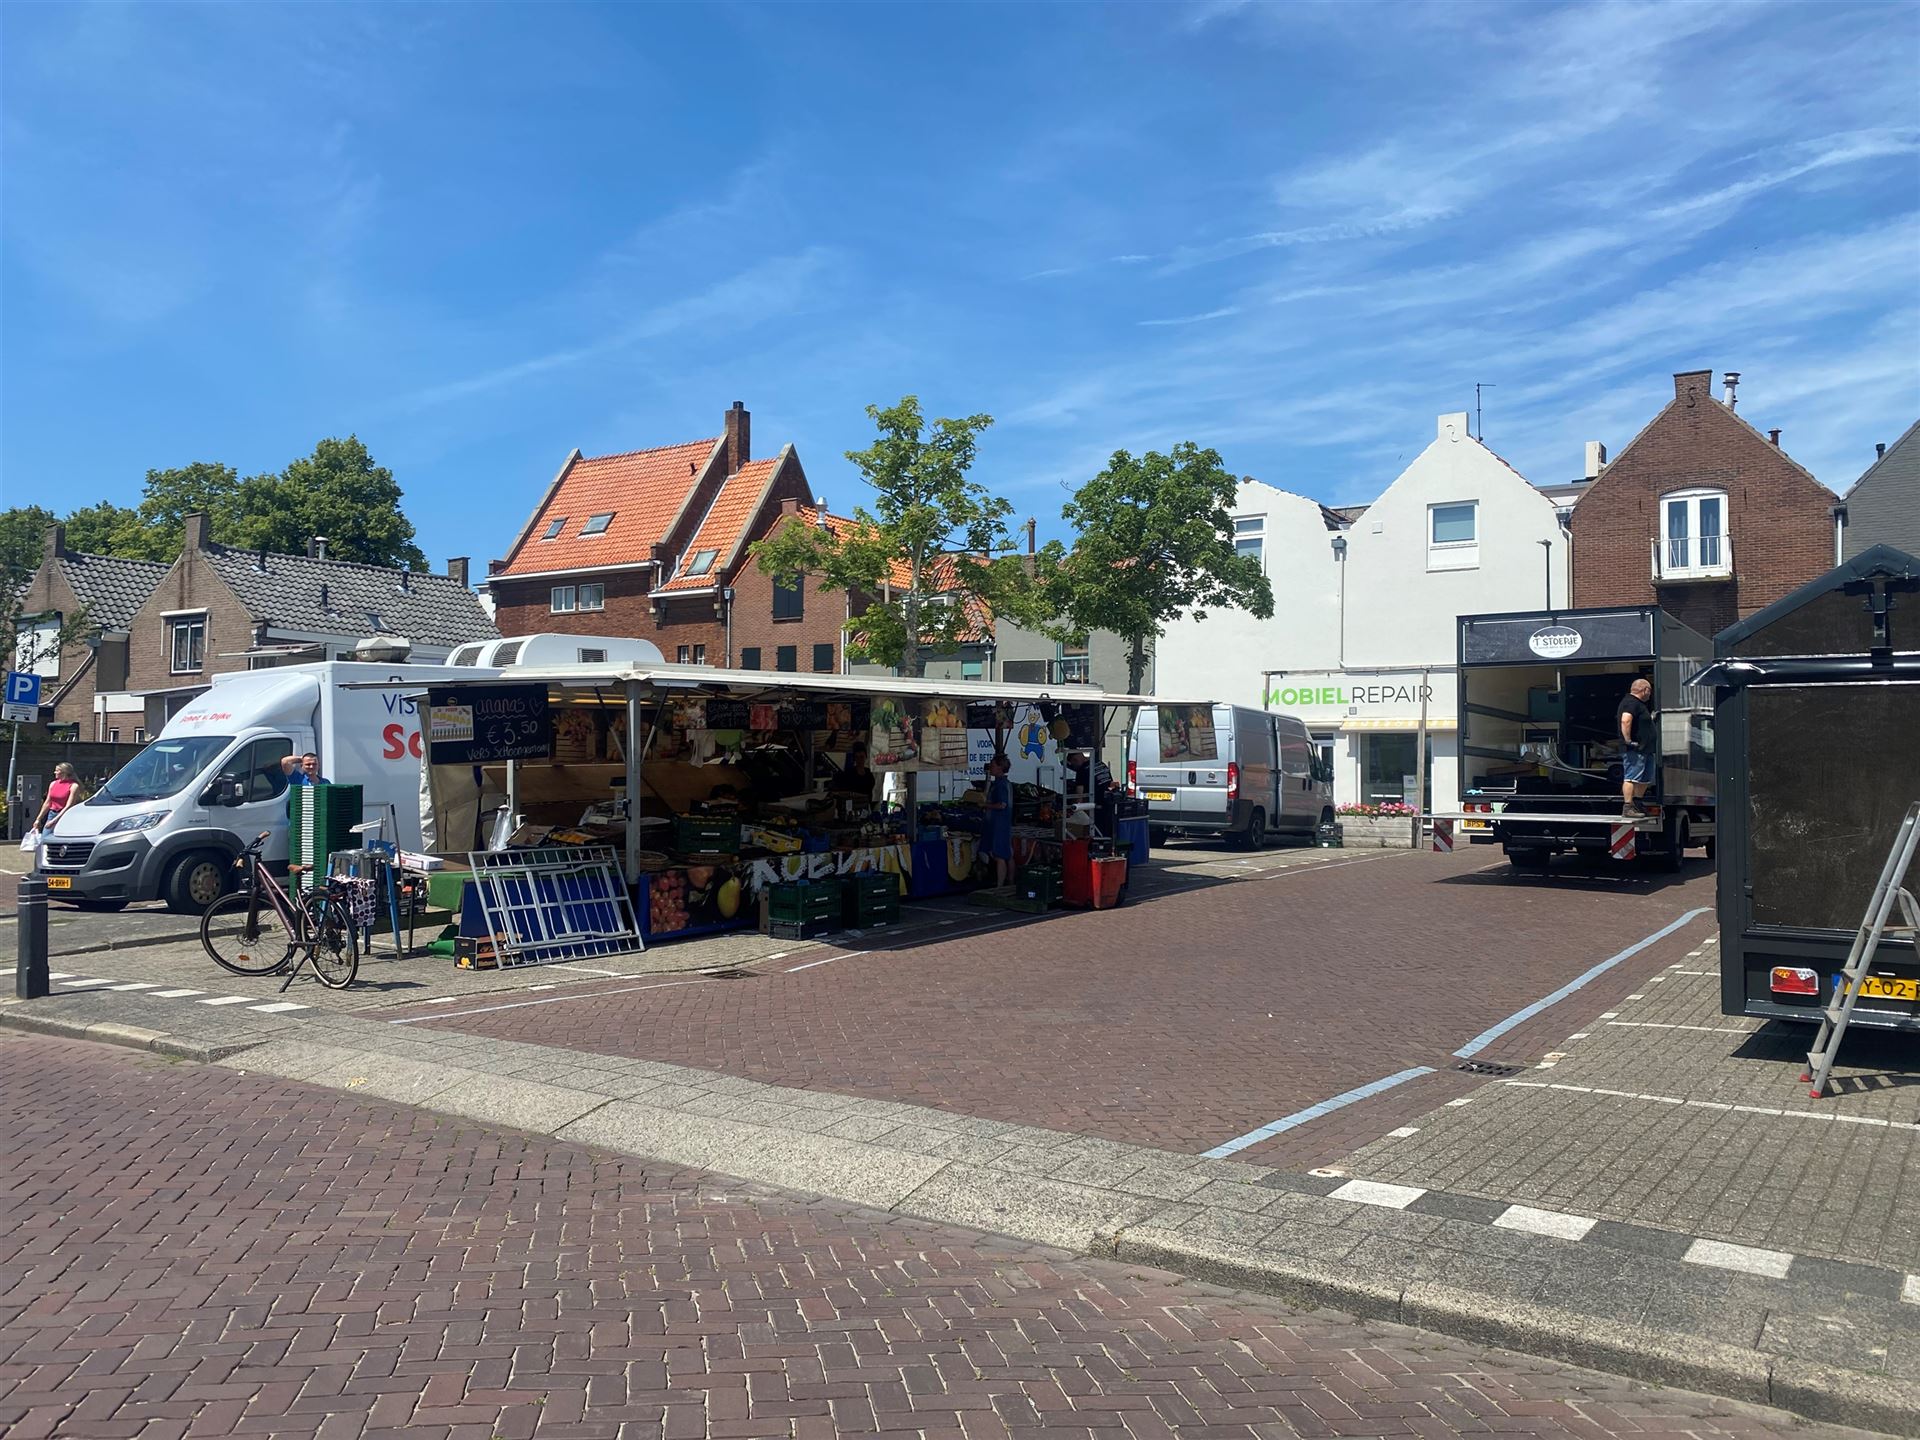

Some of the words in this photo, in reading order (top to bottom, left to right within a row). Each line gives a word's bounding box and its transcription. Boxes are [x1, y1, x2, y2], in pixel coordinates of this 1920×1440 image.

[1543, 637, 1578, 646] STOEPJE
[14, 677, 33, 700] P
[1262, 688, 1349, 705] MOBIEL
[1352, 686, 1433, 703] REPAIR
[976, 740, 992, 748] VOOR
[970, 754, 977, 762] DE
[979, 754, 993, 762] BETE
[1863, 981, 1920, 998] Y-02-
